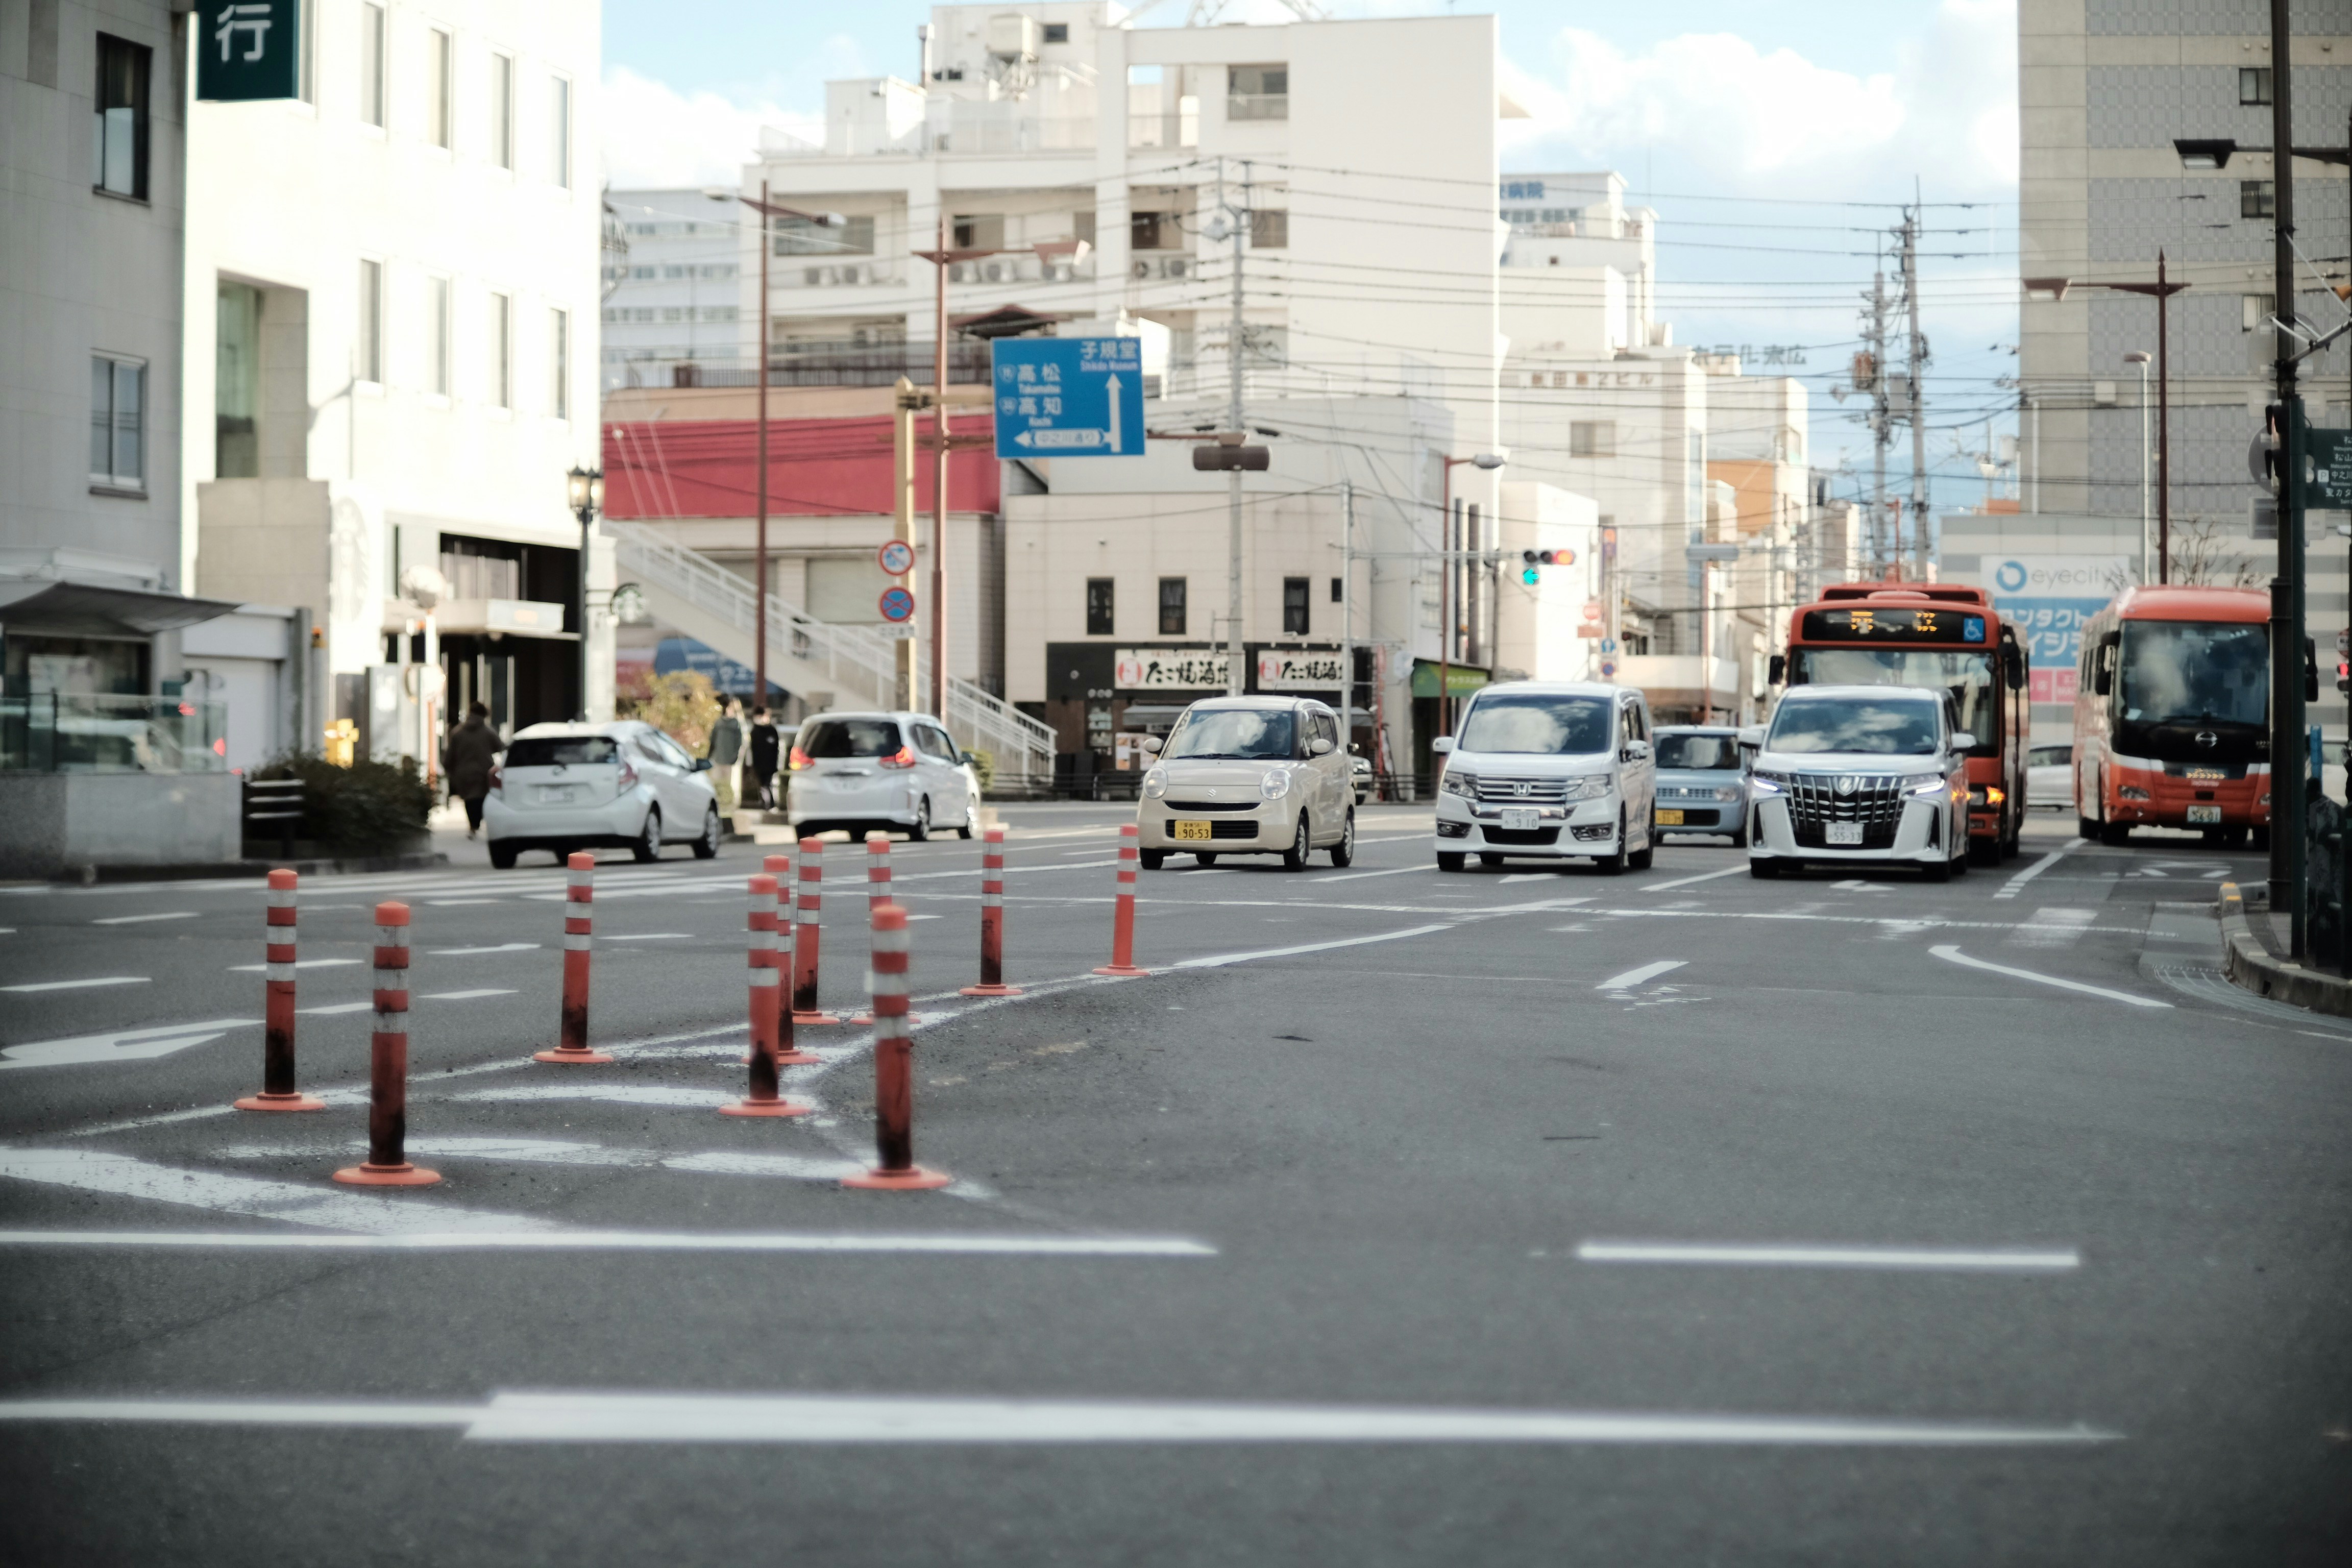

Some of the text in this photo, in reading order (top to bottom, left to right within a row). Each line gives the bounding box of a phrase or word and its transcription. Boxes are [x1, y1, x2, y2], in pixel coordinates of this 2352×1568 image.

[215, 4, 273, 62] 行
[1080, 341, 1138, 360] 子規堂
[1017, 363, 1061, 382] 高松
[1018, 396, 1062, 415] 高知
[1998, 608, 2099, 628] コンタクト
[1281, 661, 1342, 680] たこ焼酒
[1183, 829, 1209, 839] 90-53
